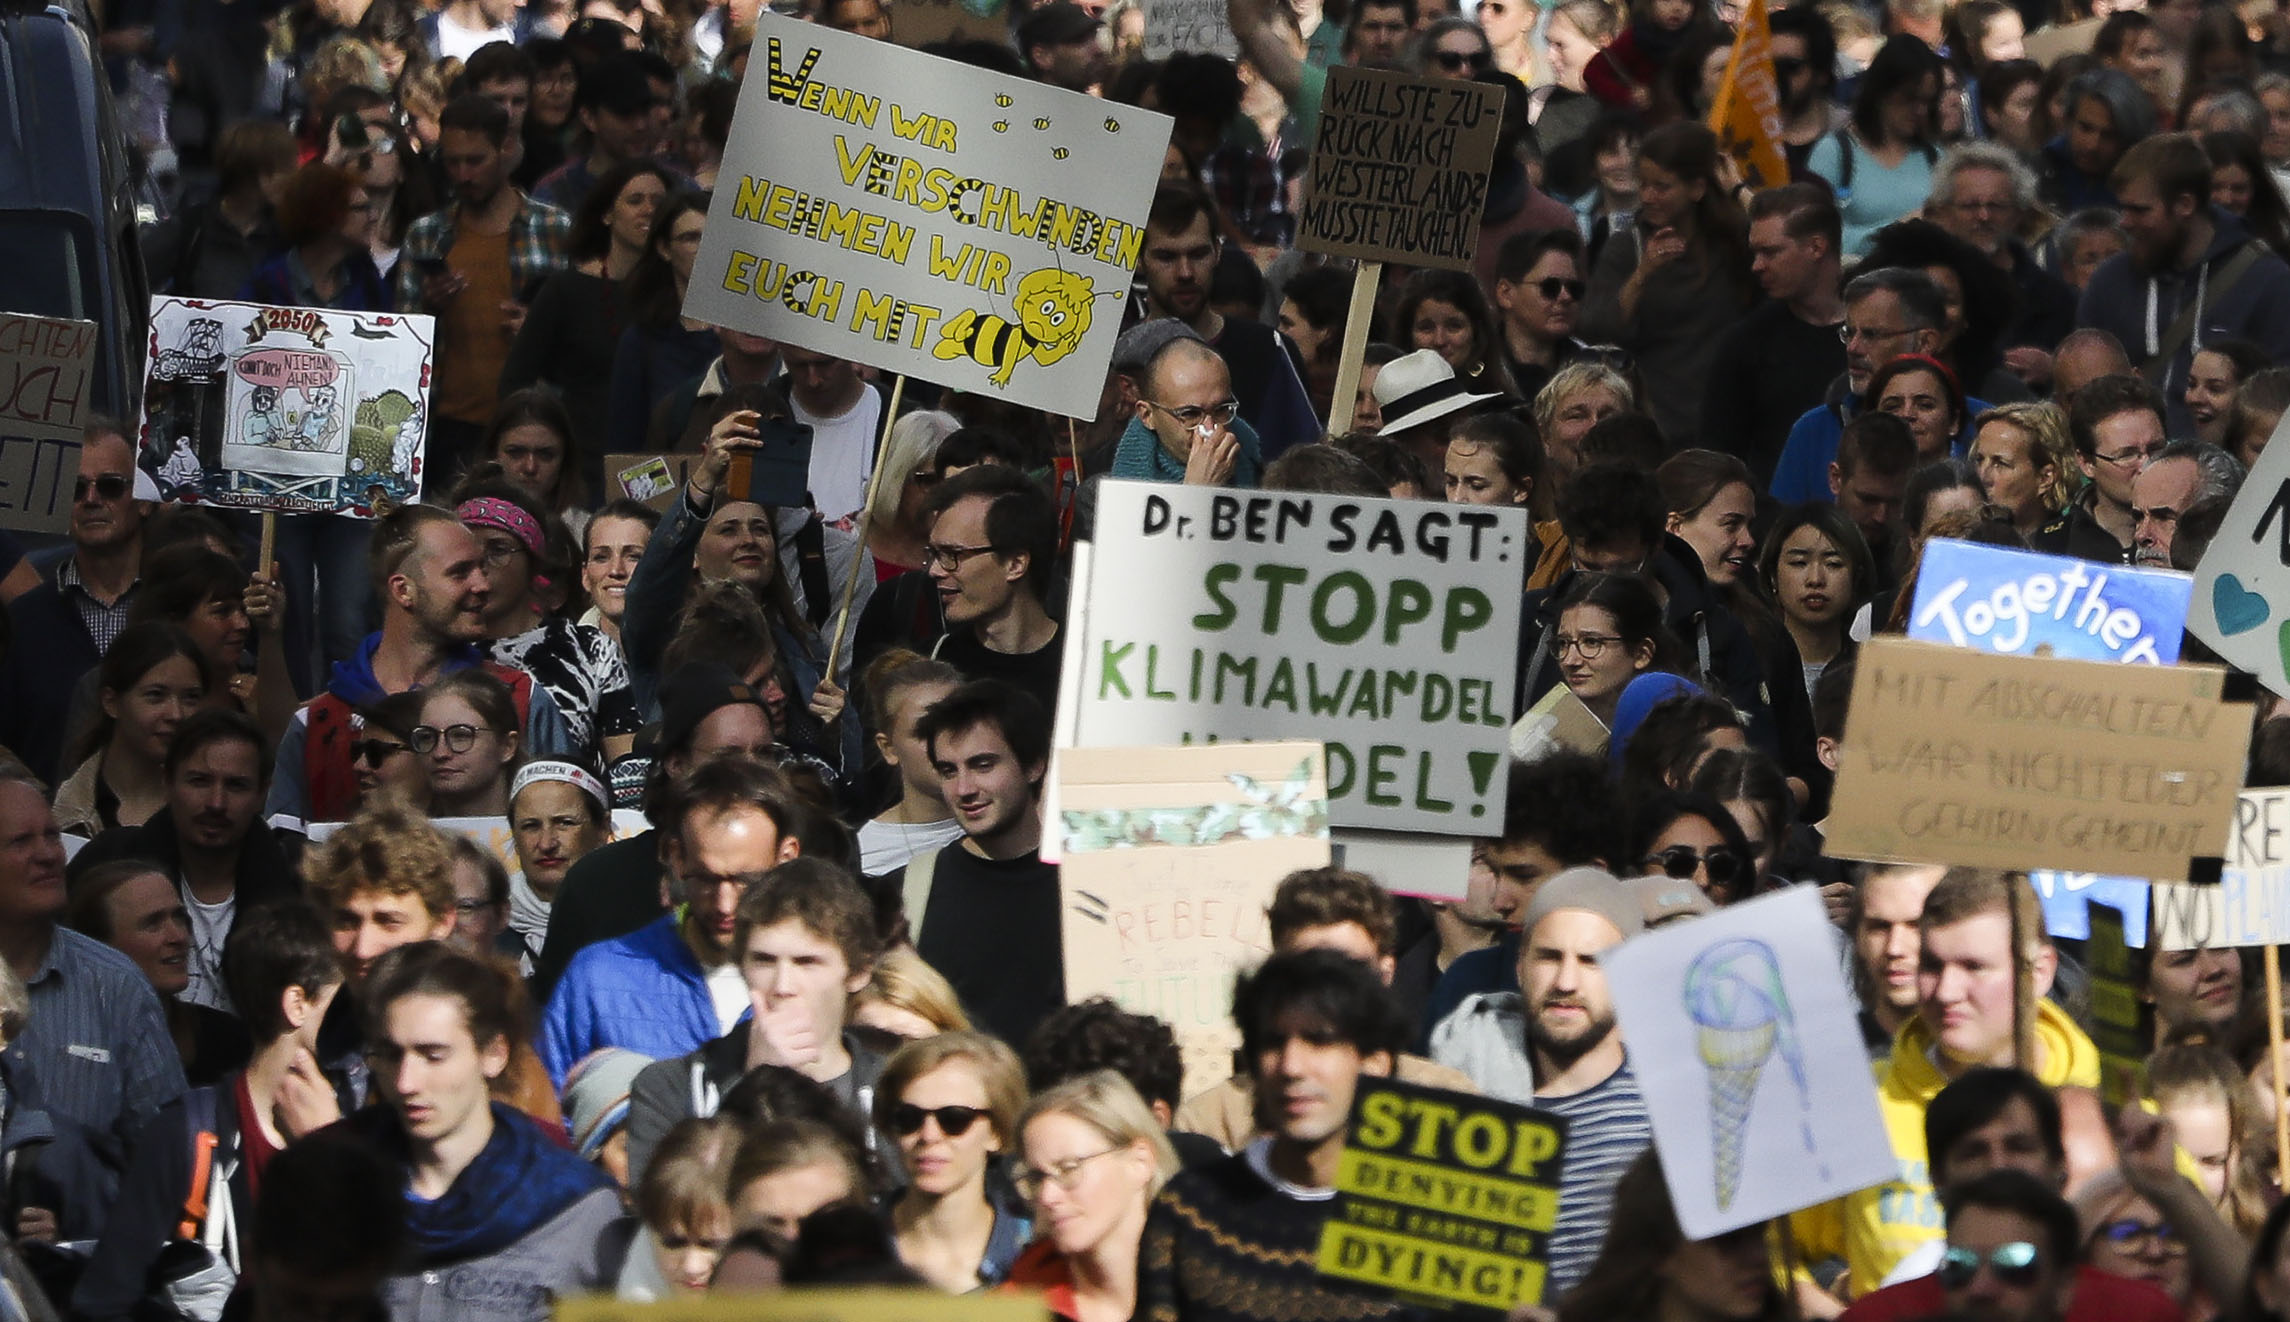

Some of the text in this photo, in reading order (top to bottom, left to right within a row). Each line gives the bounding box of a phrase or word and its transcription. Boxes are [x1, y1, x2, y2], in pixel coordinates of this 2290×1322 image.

[767, 36, 958, 153] WENN WIR
[1332, 78, 1497, 129] WILLSTE ZU-
[1389, 122, 1457, 168] NACH
[733, 174, 1013, 295] NEHMEN WIR
[833, 136, 1144, 272] VERSCHWINDEN
[1301, 197, 1473, 260] MUSSTE TAUCHEN.
[268, 308, 315, 332] 2050
[723, 250, 942, 350] EUCH MIT
[1143, 494, 1511, 564] Dr. BEN SAGT:
[1192, 562, 1494, 654] STOPP
[1917, 561, 2161, 667] Together
[1099, 640, 1507, 728] KLIMAWANDEL
[1873, 667, 1957, 708] MIT
[2224, 797, 2284, 868] RE
[1359, 1092, 1560, 1178] STOP
[1353, 1155, 1538, 1219] DENYING
[1338, 1235, 1525, 1302] DYING!
